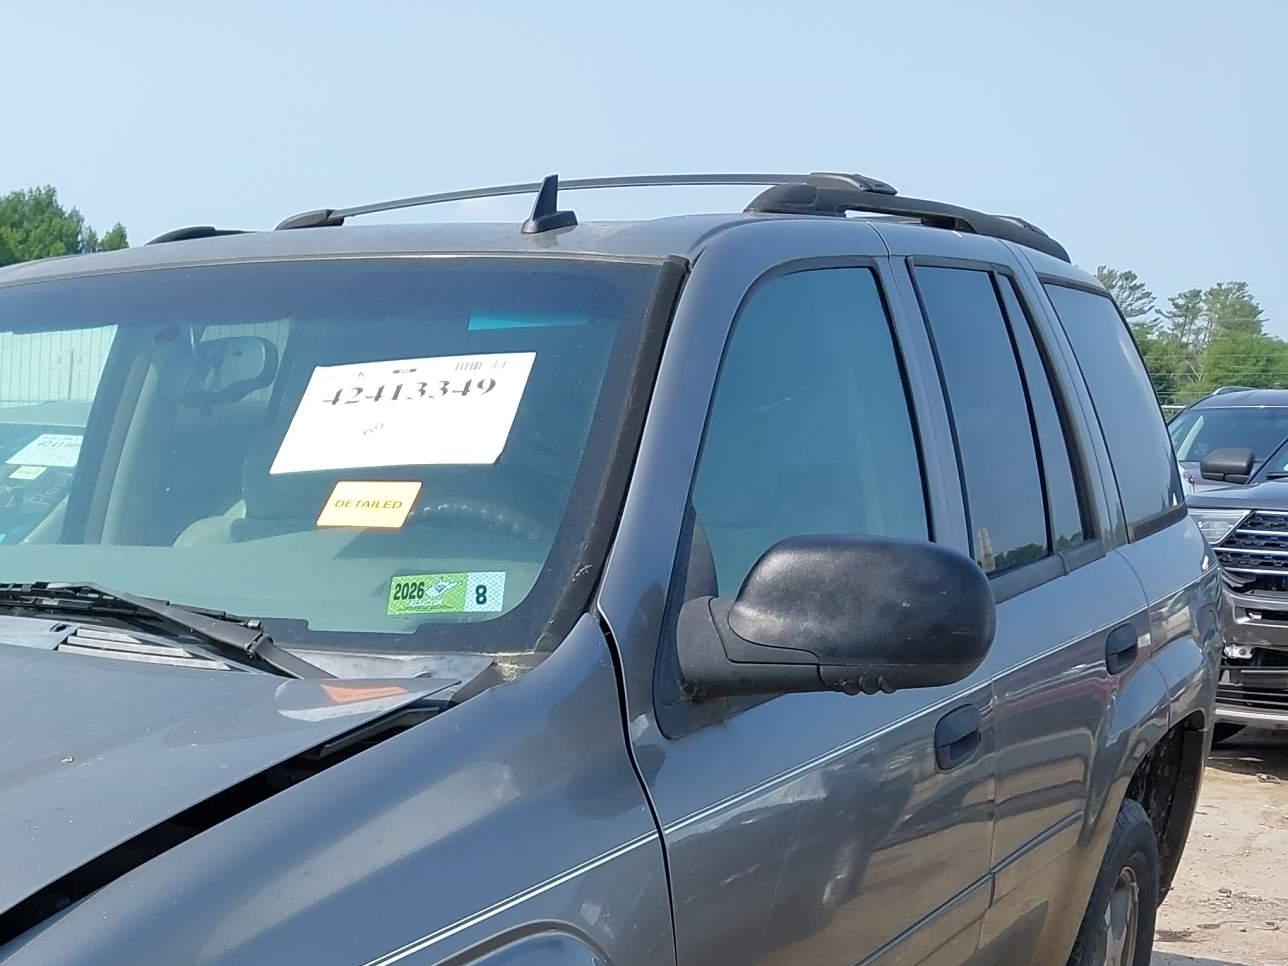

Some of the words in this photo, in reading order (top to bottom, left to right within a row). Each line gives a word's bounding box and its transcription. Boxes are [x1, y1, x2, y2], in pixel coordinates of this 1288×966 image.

[322, 377, 497, 406] 42413349
[333, 498, 403, 510] DETAILED
[393, 581, 425, 601] 2026
[475, 584, 487, 605] 8
